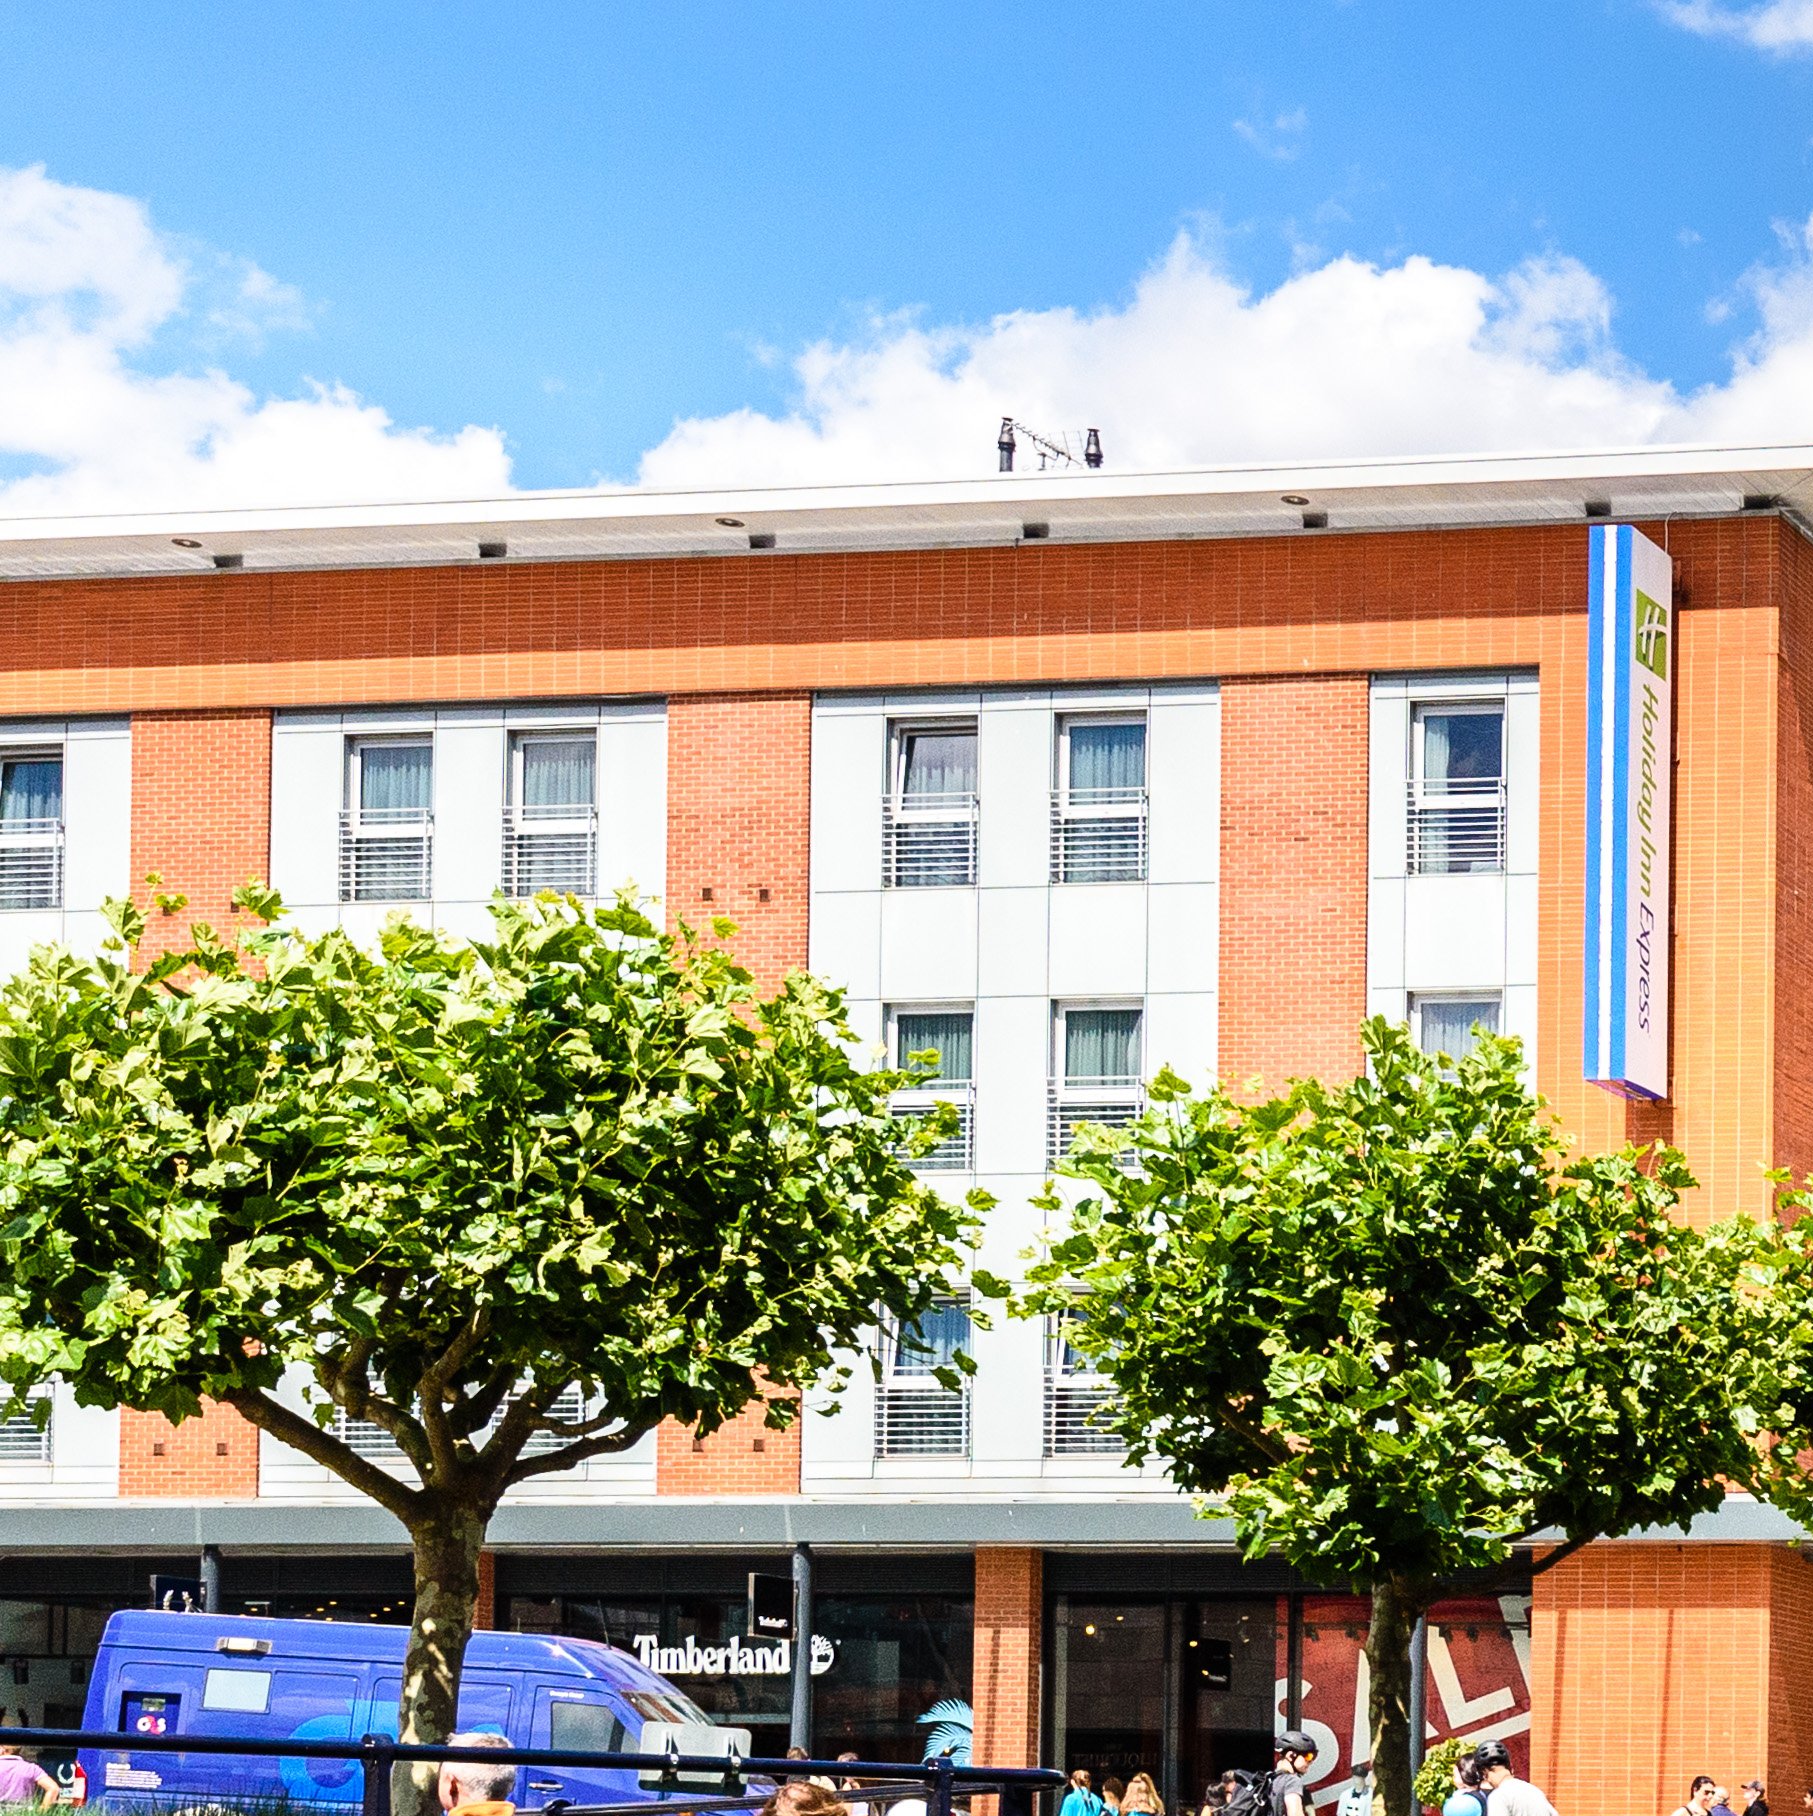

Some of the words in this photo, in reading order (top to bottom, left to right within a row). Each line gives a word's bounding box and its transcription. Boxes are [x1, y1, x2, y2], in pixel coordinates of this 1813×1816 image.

[1637, 683, 1659, 834] Holiday
[1640, 835, 1657, 898] Inn
[1636, 902, 1655, 1033] Express
[633, 1633, 792, 1675] Timberland
